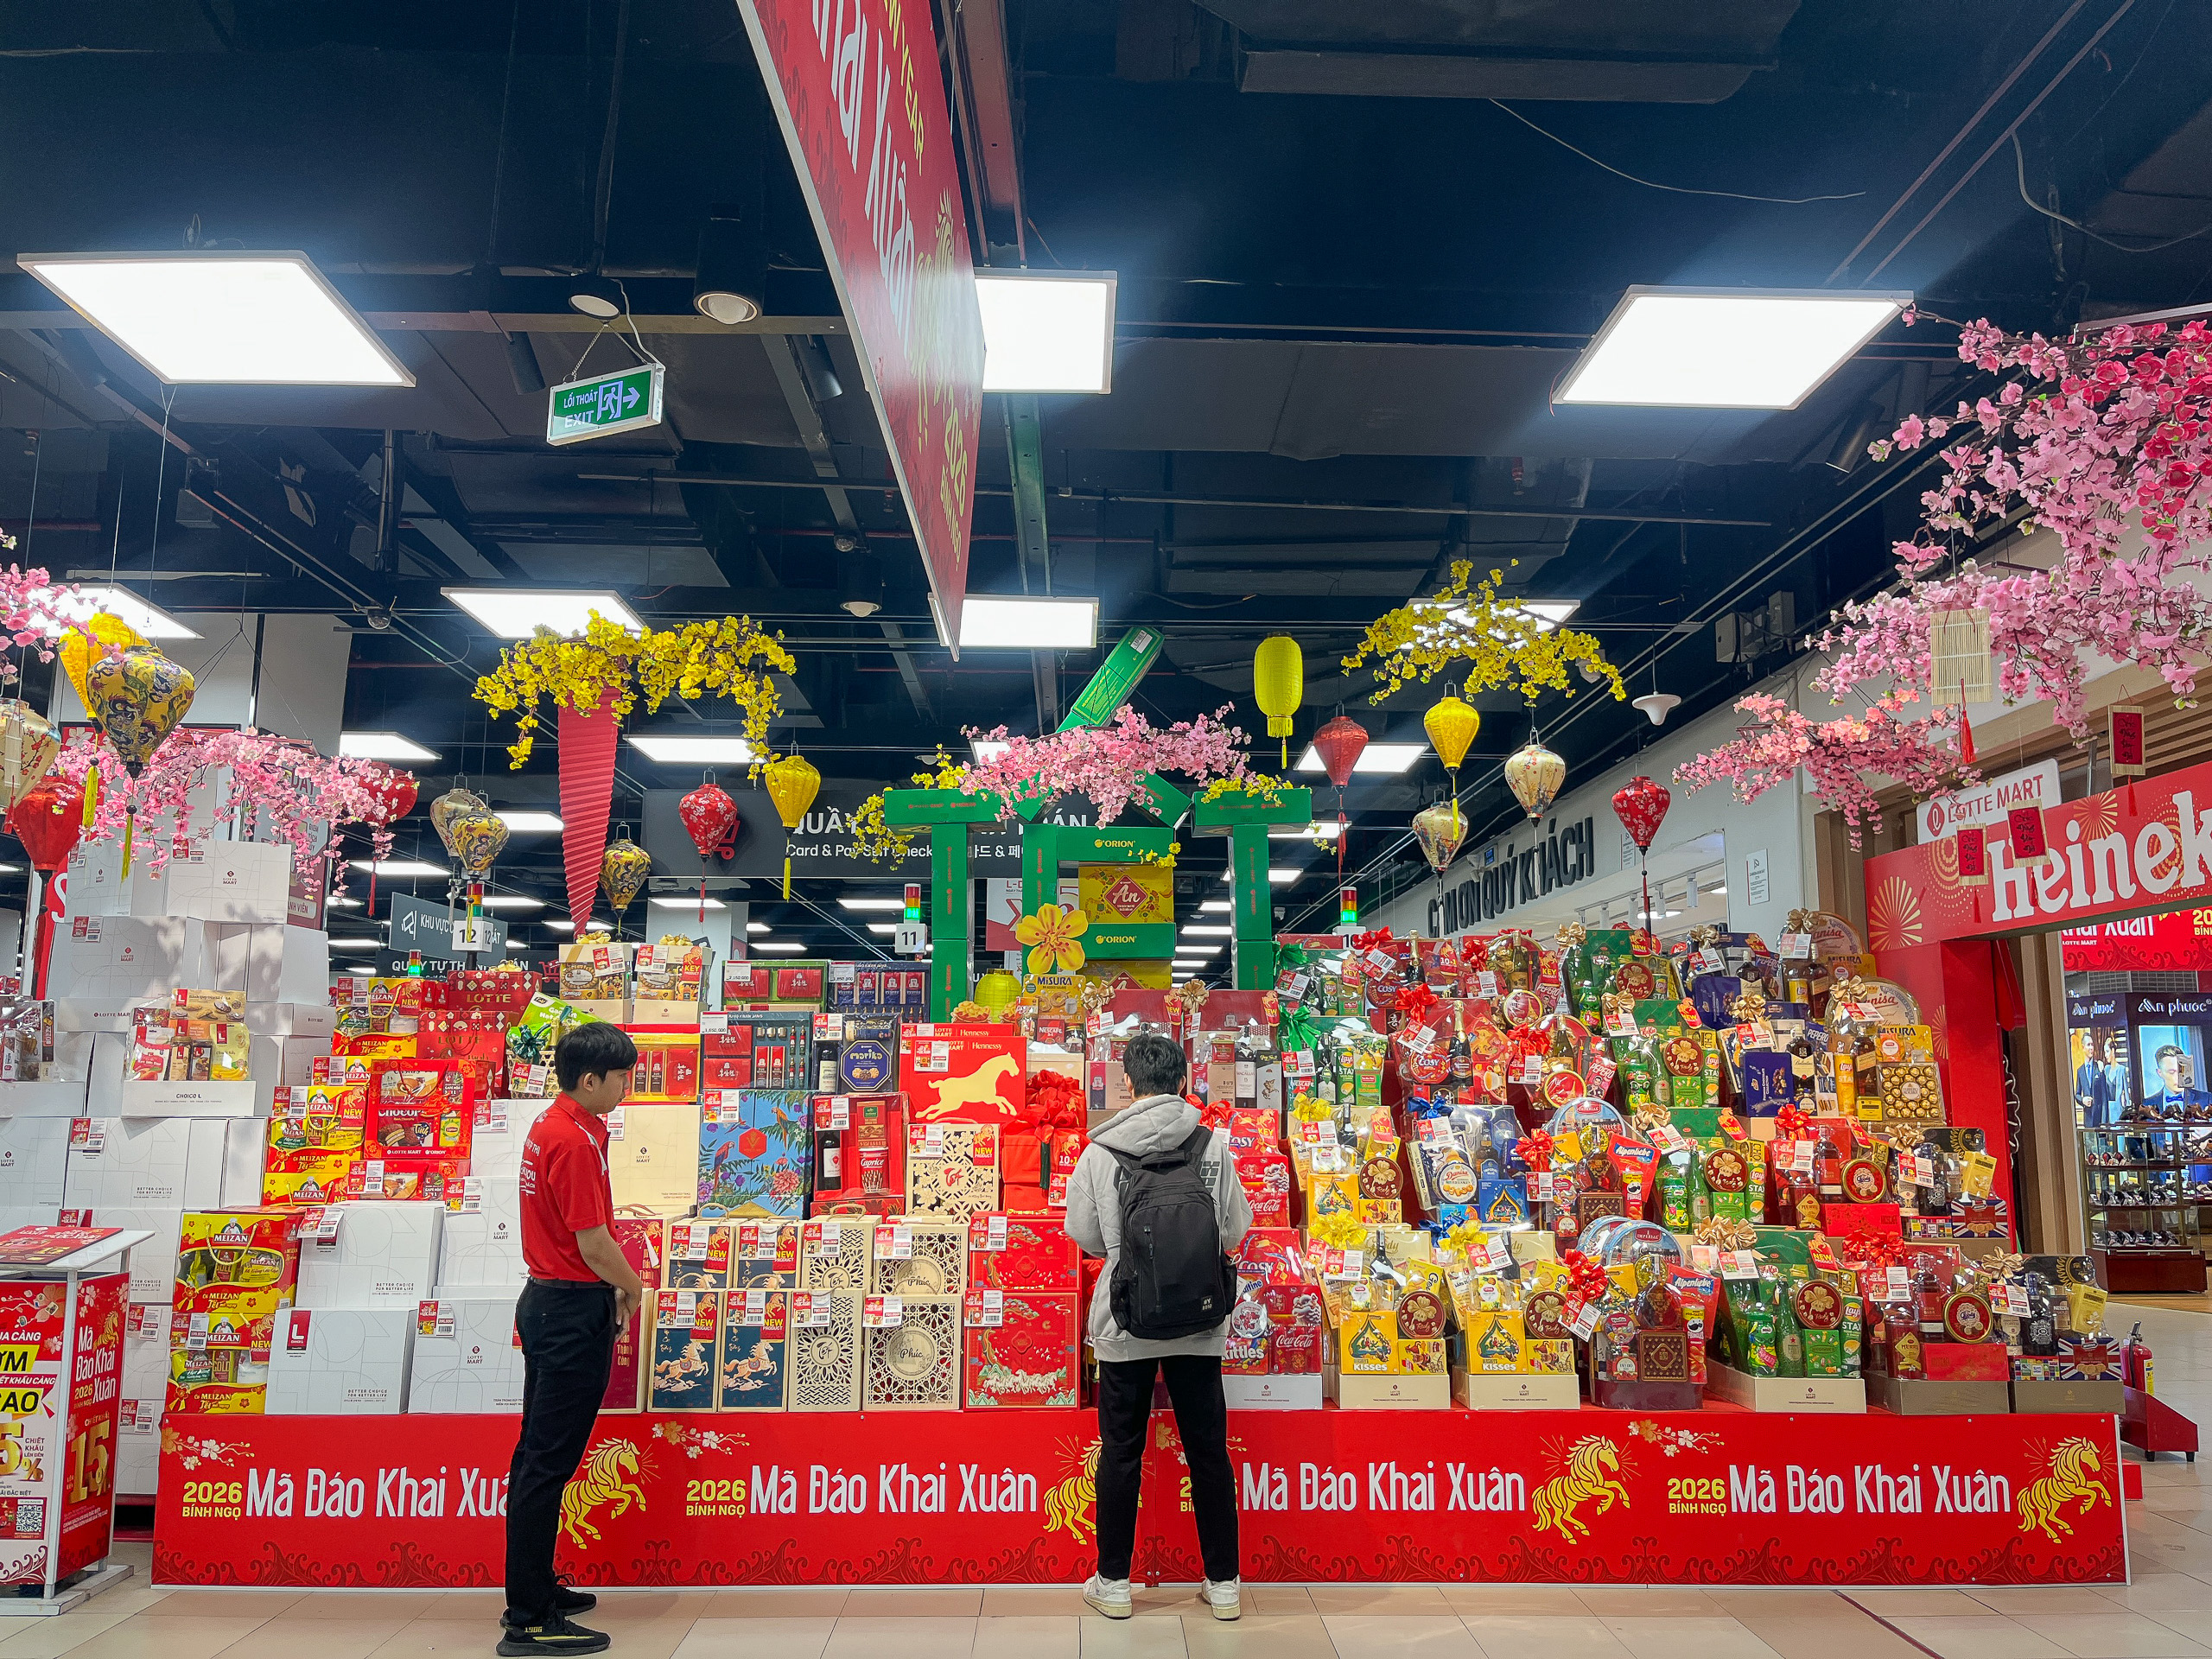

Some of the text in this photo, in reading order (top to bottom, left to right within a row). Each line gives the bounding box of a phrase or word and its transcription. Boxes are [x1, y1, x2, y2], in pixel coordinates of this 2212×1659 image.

[900, 19, 925, 177] YEAR
[864, 29, 915, 360] Xuân
[563, 389, 598, 409] LỐI THOÁT
[564, 410, 594, 429] EXIT
[944, 386, 968, 518] 2026
[1997, 774, 2044, 809] MART
[786, 844, 860, 859] Card & Pay
[995, 844, 1006, 857] &
[1482, 844, 1518, 919] QUÝ
[1520, 814, 1594, 905] KHÁCH
[1112, 884, 1141, 905] An
[420, 914, 452, 935] KHU VỰC
[459, 928, 477, 944] 12
[484, 929, 491, 944] 12
[901, 931, 918, 946] 11
[467, 994, 511, 1003] LOTTE
[1807, 1029, 1829, 1042] PEPERO
[972, 1041, 1003, 1051] Hennessy
[1258, 1128, 1274, 1136] KEY
[1615, 1145, 1654, 1157] Alpenliebe
[860, 1158, 885, 1167] Caprice
[214, 1234, 249, 1243] MEIZAN
[707, 1249, 728, 1258] NEW
[11, 1330, 41, 1341] CÀNG
[78, 1325, 93, 1353] Mã
[207, 1333, 240, 1342] MEIZAN
[94, 1344, 116, 1375] Khai
[899, 1349, 923, 1358] Phúc
[1222, 1344, 1265, 1361] kittles
[75, 1355, 94, 1382] Đáo
[10, 1375, 56, 1385] KHẤU CÀNG
[74, 1383, 93, 1400] 2026
[92, 1376, 117, 1404] Xuân
[182, 1482, 242, 1503] 2026
[245, 1467, 292, 1517] Mã
[304, 1467, 365, 1518] Đáo
[375, 1465, 447, 1518] Khai
[686, 1480, 746, 1501] 2026
[749, 1463, 1037, 1514] Mã Đáo Khai Xuân
[1242, 1463, 1288, 1511] Mã
[1300, 1463, 1357, 1511] Đáo
[1368, 1461, 1435, 1511] Khai
[1446, 1462, 1525, 1511] Xuân
[1667, 1478, 1726, 1500] 2026
[1729, 1463, 2011, 1513] Mã Đáo Khai Xuân
[182, 1503, 242, 1522] BÍNH NGỌ
[686, 1503, 745, 1519] BÍNH NGỌ
[1669, 1502, 1727, 1517] BÍNH NGỌ
